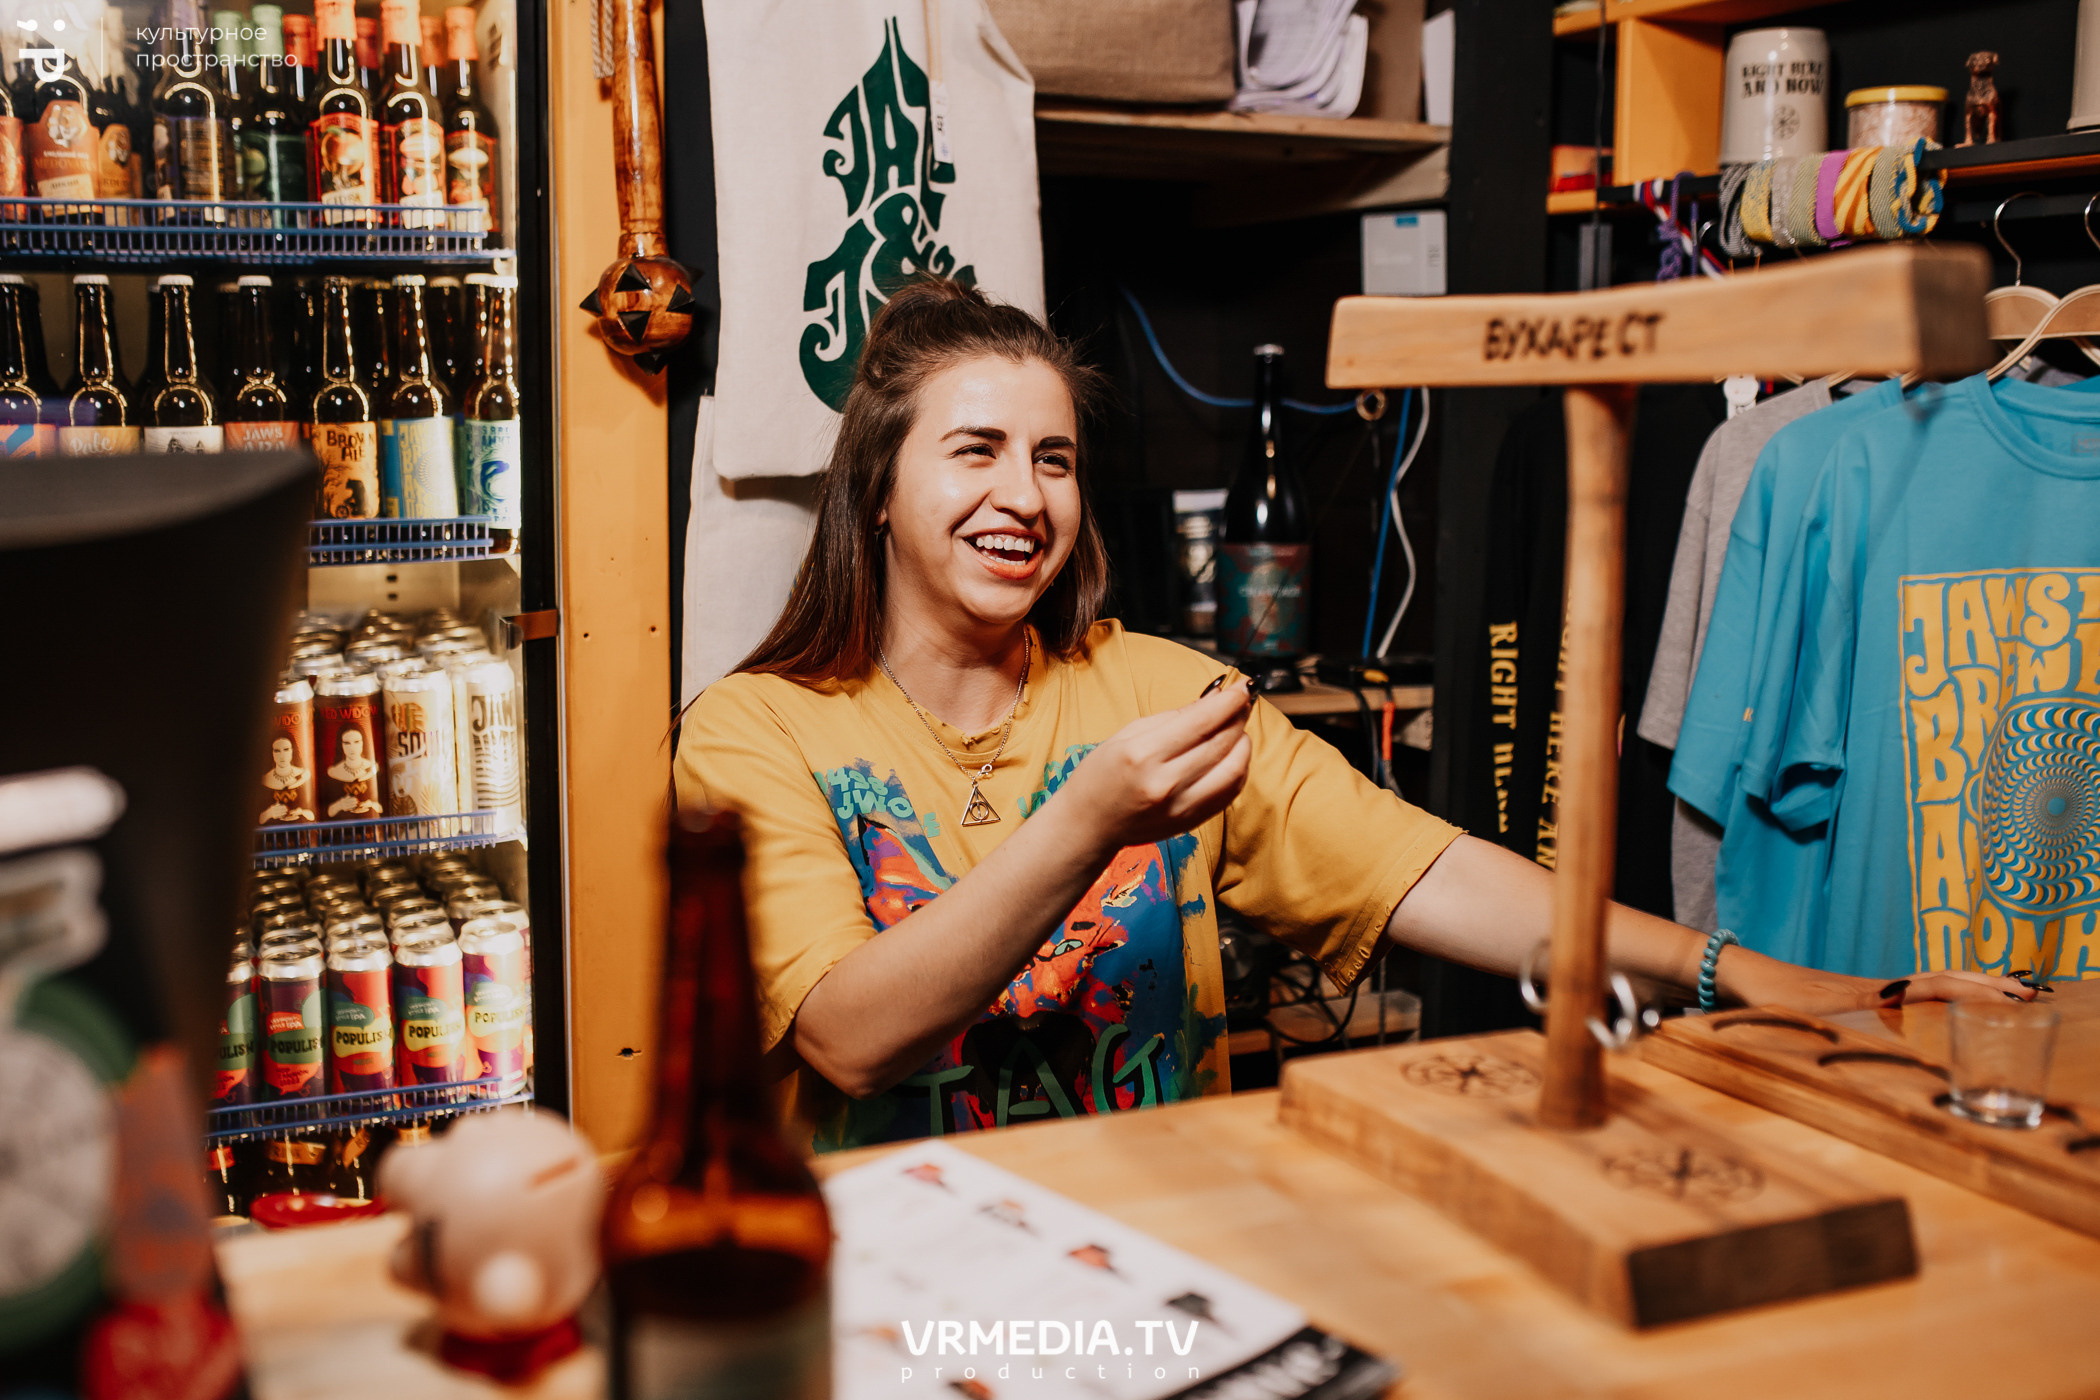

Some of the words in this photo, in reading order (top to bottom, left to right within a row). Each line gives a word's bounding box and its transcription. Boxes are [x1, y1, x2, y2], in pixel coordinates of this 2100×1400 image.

[1786, 79, 1824, 95] NOW
[1483, 312, 1664, 361] БУХАРЕСТ
[71, 432, 115, 457] Pale
[243, 426, 283, 441] JAWS
[326, 429, 376, 448] BROWN
[1904, 573, 2071, 697] JAWS
[1489, 620, 1519, 730] RIGHT
[272, 711, 311, 727] WIDO
[1493, 741, 1515, 834] HE
